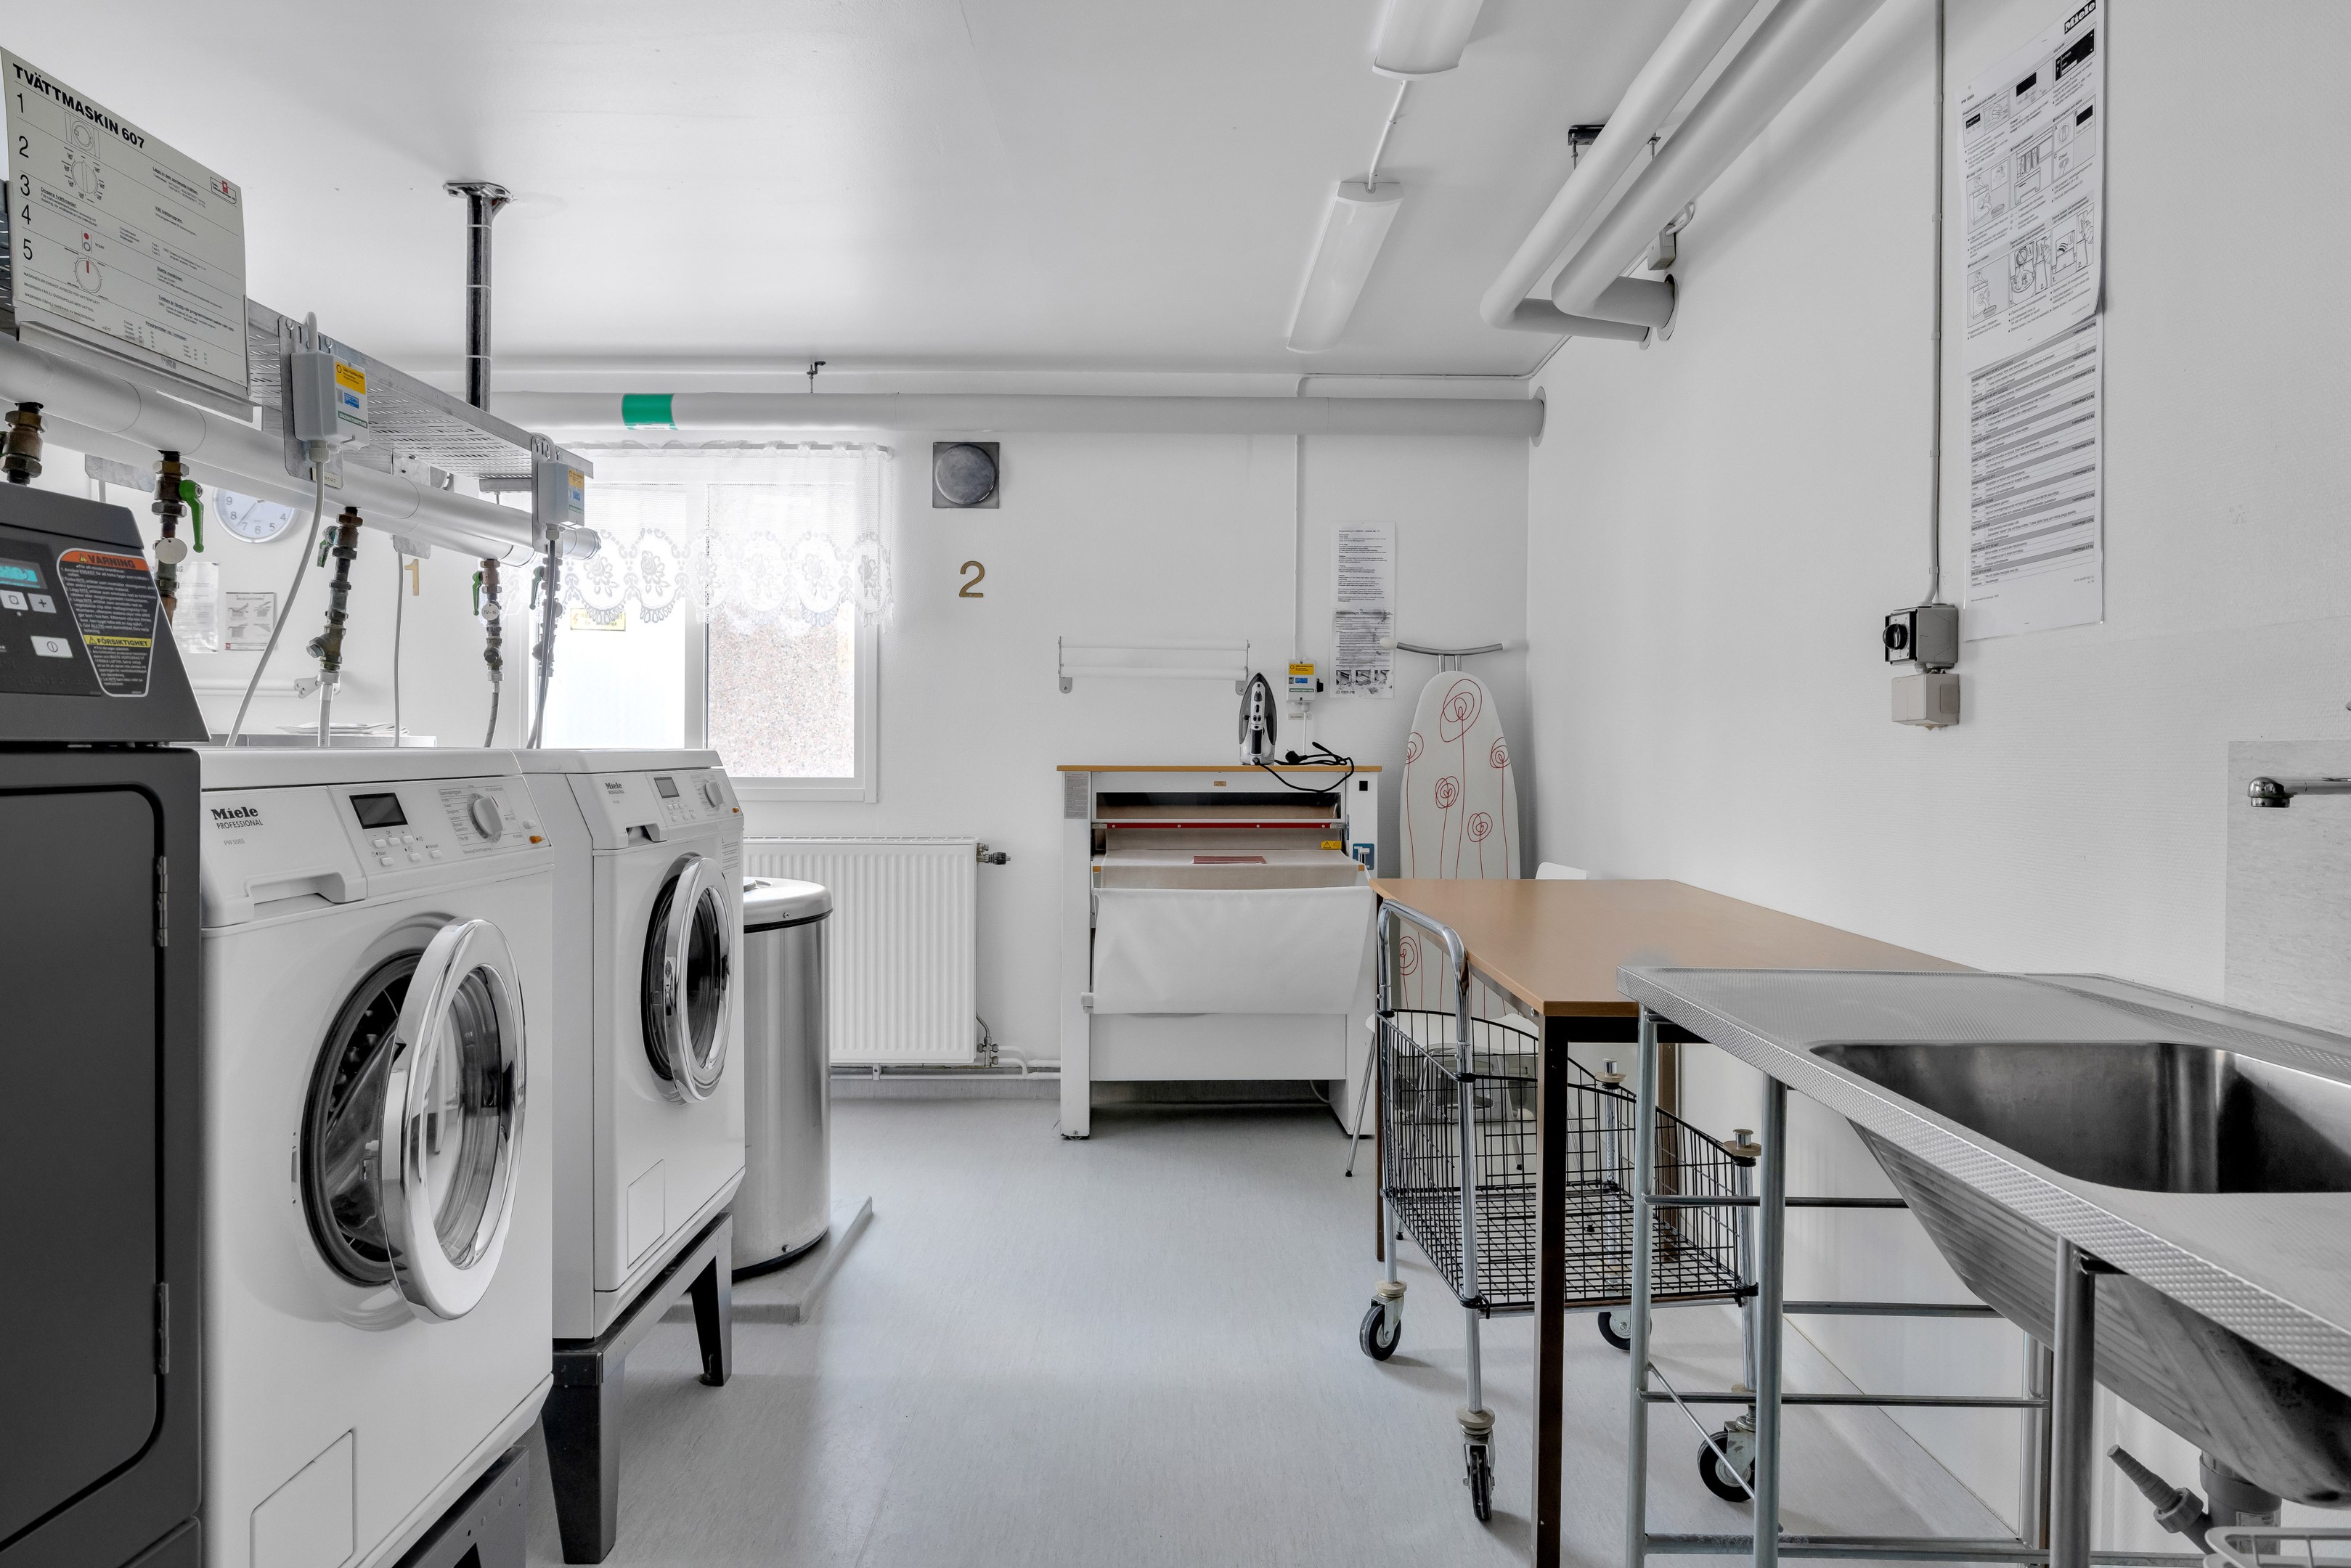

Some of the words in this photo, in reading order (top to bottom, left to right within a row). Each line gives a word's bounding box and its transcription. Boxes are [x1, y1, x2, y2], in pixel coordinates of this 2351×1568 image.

[2064, 2, 2095, 33] Miele
[12, 62, 119, 135] TVÄTTMASKIN
[121, 127, 144, 149] 607
[17, 93, 24, 113] 1
[18, 135, 29, 158] 2
[20, 174, 30, 197] 3
[40, 185, 54, 197] Dosera
[21, 204, 31, 225] 4
[23, 238, 33, 260] 5
[94, 242, 105, 250] START
[23, 271, 40, 282] MASKINEN
[46, 279, 59, 290] ENDAST
[23, 280, 41, 293] MASKINEN
[24, 290, 41, 303] MASKINEN
[226, 497, 232, 505] 9
[230, 511, 237, 520] 8
[280, 513, 286, 521] 4
[242, 522, 248, 531] 7
[254, 526, 261, 534] 6
[269, 523, 275, 531] 5
[88, 555, 136, 568] VARNING
[404, 558, 419, 597] 1
[959, 560, 985, 598] 2
[97, 637, 148, 647] FÖRSIKTIGHET
[211, 807, 259, 820] Miele
[216, 819, 264, 830] PROFESSIONAL
